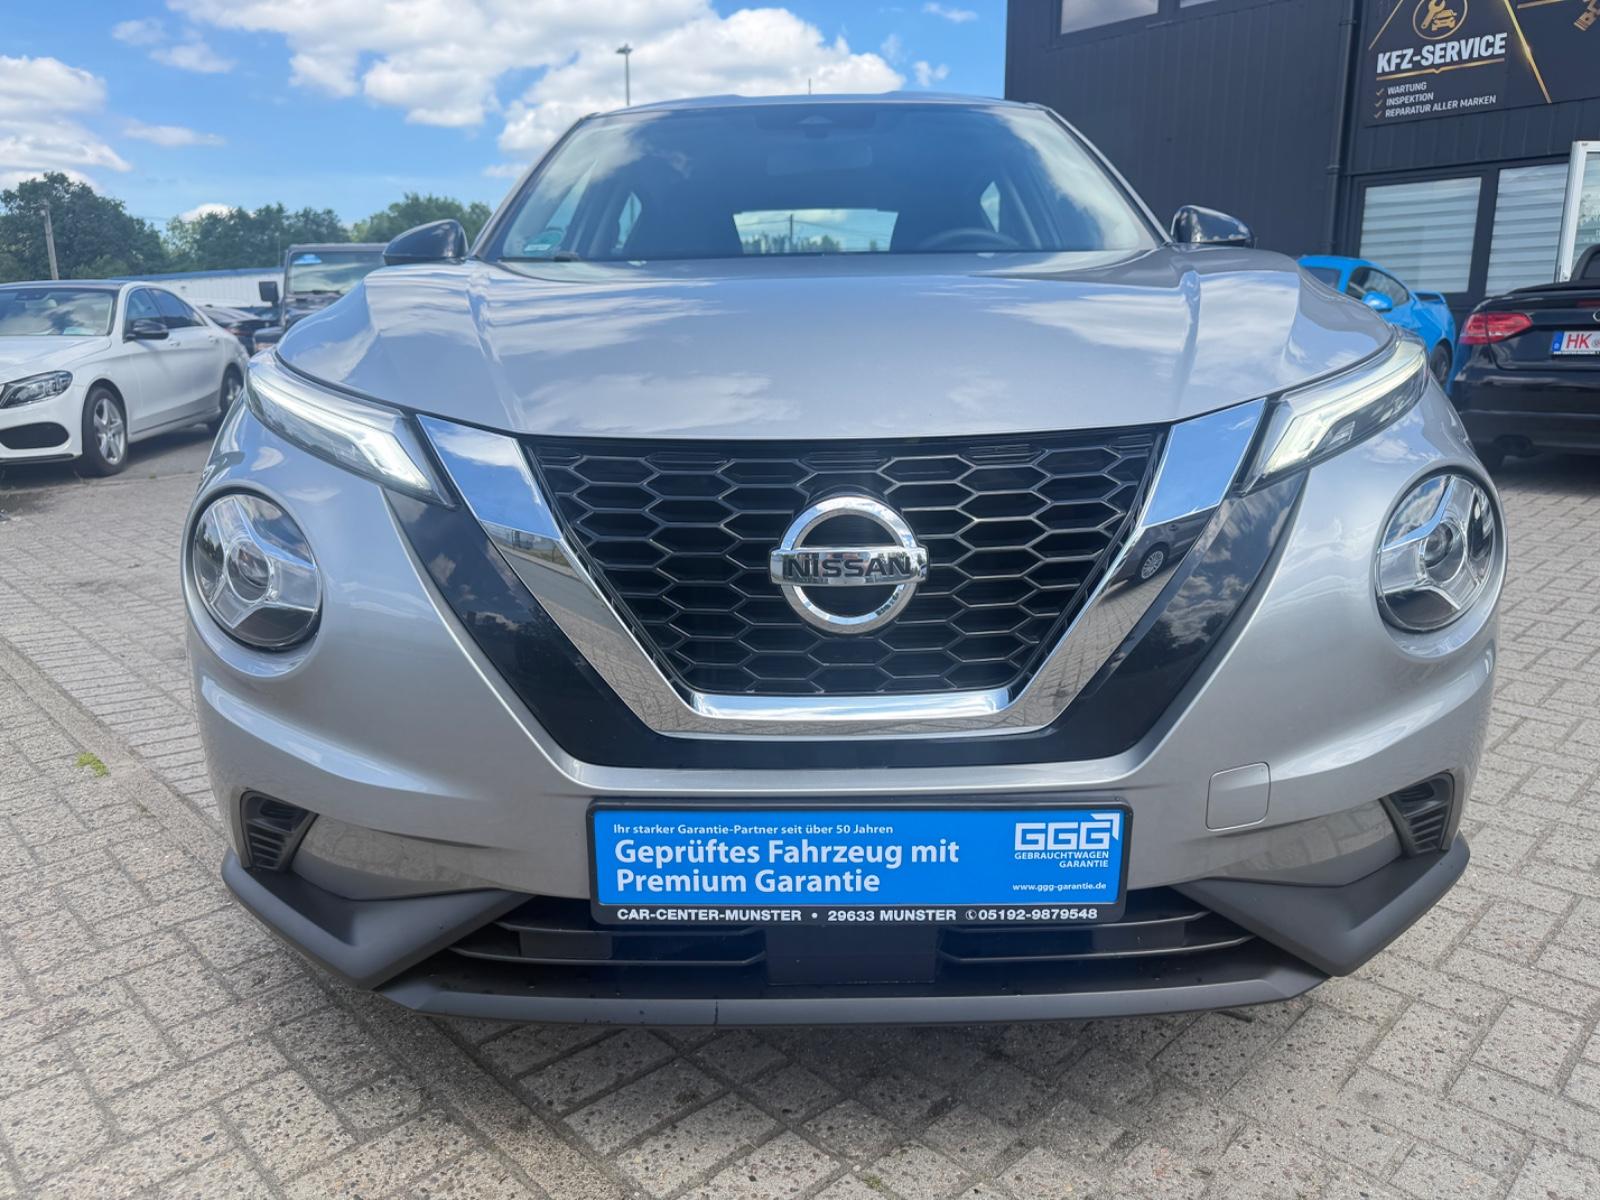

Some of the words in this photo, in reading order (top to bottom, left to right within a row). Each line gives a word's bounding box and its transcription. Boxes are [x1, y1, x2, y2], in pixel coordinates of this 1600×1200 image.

[1376, 32, 1508, 73] KFZ-SERVICE
[1387, 82, 1427, 95] WARTUNG
[1386, 92, 1434, 106] INSPEKTION
[1385, 104, 1431, 118] REPARATUR
[1432, 100, 1458, 112] ALLER
[1460, 95, 1497, 108] MARKEN
[782, 556, 911, 577] NISSAN
[613, 824, 631, 834] Ihr
[633, 824, 675, 834] starker
[677, 824, 778, 834] Garantie-Partner
[780, 824, 802, 834] seit
[805, 824, 833, 834] über
[836, 824, 851, 834] 50
[853, 824, 893, 834] Jahren
[1014, 821, 1111, 850] GGG
[614, 839, 761, 869] Geprüftes
[768, 839, 902, 869] Fahrzeug
[911, 838, 960, 863] mit
[1014, 851, 1109, 860] GEBRAUCHTWAGEN
[1058, 860, 1109, 868] GARANTIE
[616, 868, 747, 893] Premium
[754, 868, 881, 893] Garantie
[1012, 882, 1107, 892] www.ggg-garantie.de
[616, 909, 802, 922] CAR-CENTER-MUNSTER
[827, 910, 875, 922] 29633
[880, 909, 957, 922] MUNSTER
[978, 908, 1098, 921] 05192-9879548
